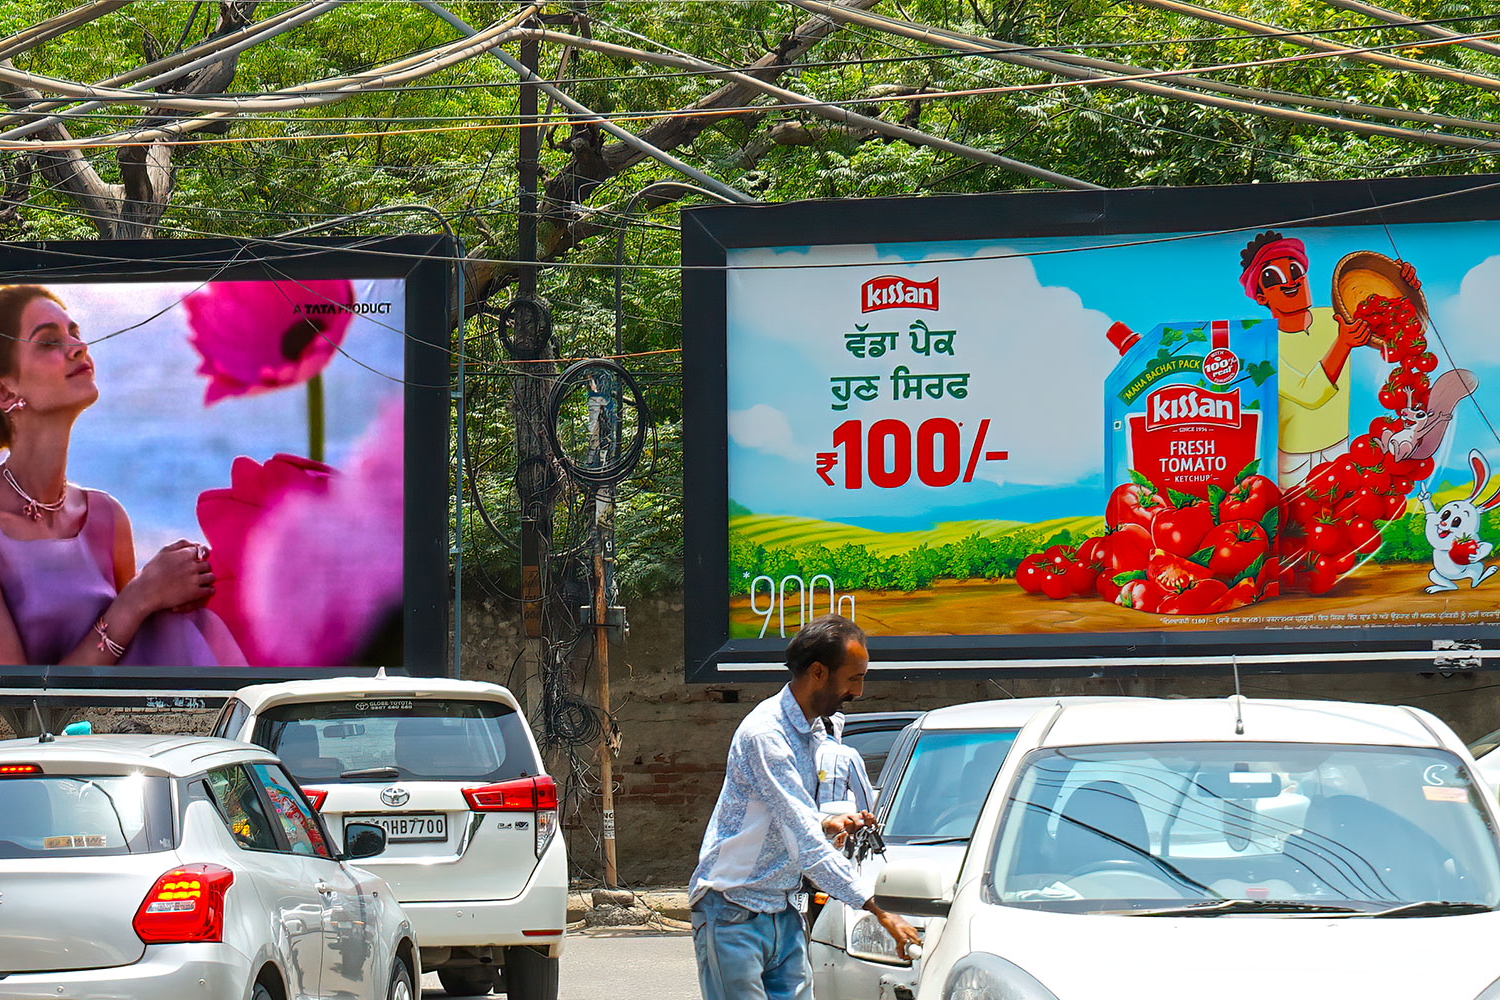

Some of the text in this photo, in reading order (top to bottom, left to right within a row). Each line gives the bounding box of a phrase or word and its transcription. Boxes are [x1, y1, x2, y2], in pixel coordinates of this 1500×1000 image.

[304, 303, 336, 314] TATA
[338, 303, 391, 314] PRODUCT
[844, 319, 956, 358] ਵੱਡਾ ਪੈਕ
[1124, 358, 1201, 400] MAHA BACHAT PACK
[830, 365, 971, 411] ਹੁਣ ਸਿਰਫ
[1170, 439, 1215, 456] FRESH
[1158, 456, 1227, 473] TOMATO
[356, 819, 443, 834] 0HB7700
